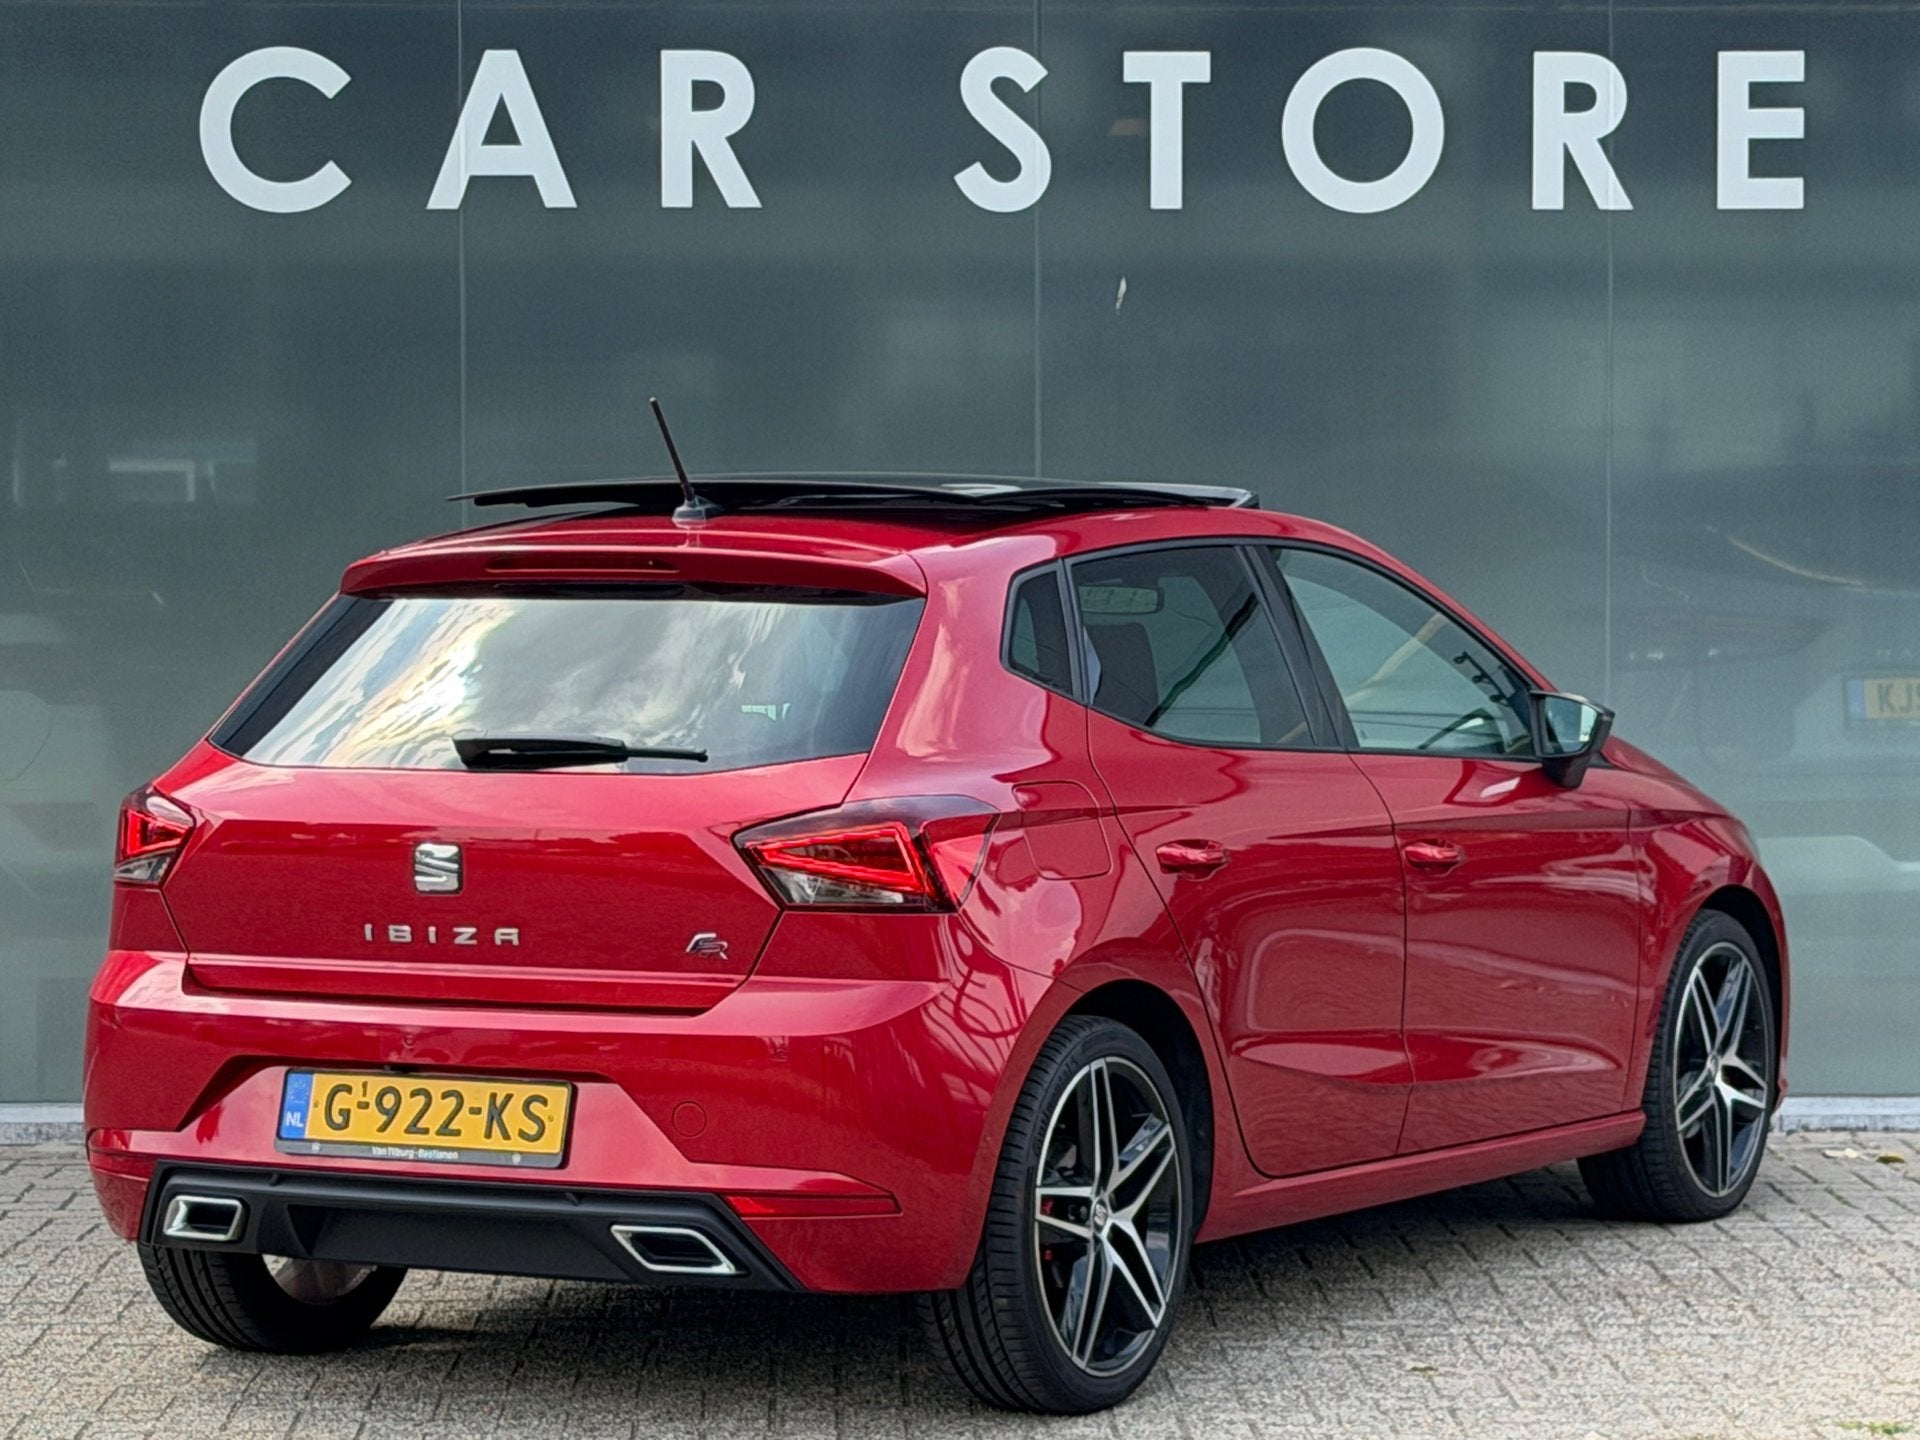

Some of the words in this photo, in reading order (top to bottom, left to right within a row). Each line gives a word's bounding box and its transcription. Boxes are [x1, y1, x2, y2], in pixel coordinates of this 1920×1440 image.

[200, 46, 762, 213] CAR
[954, 46, 1804, 213] STORE
[364, 923, 520, 946] IBIZA
[285, 1111, 304, 1128] NL
[324, 1082, 549, 1142] G-922-KS
